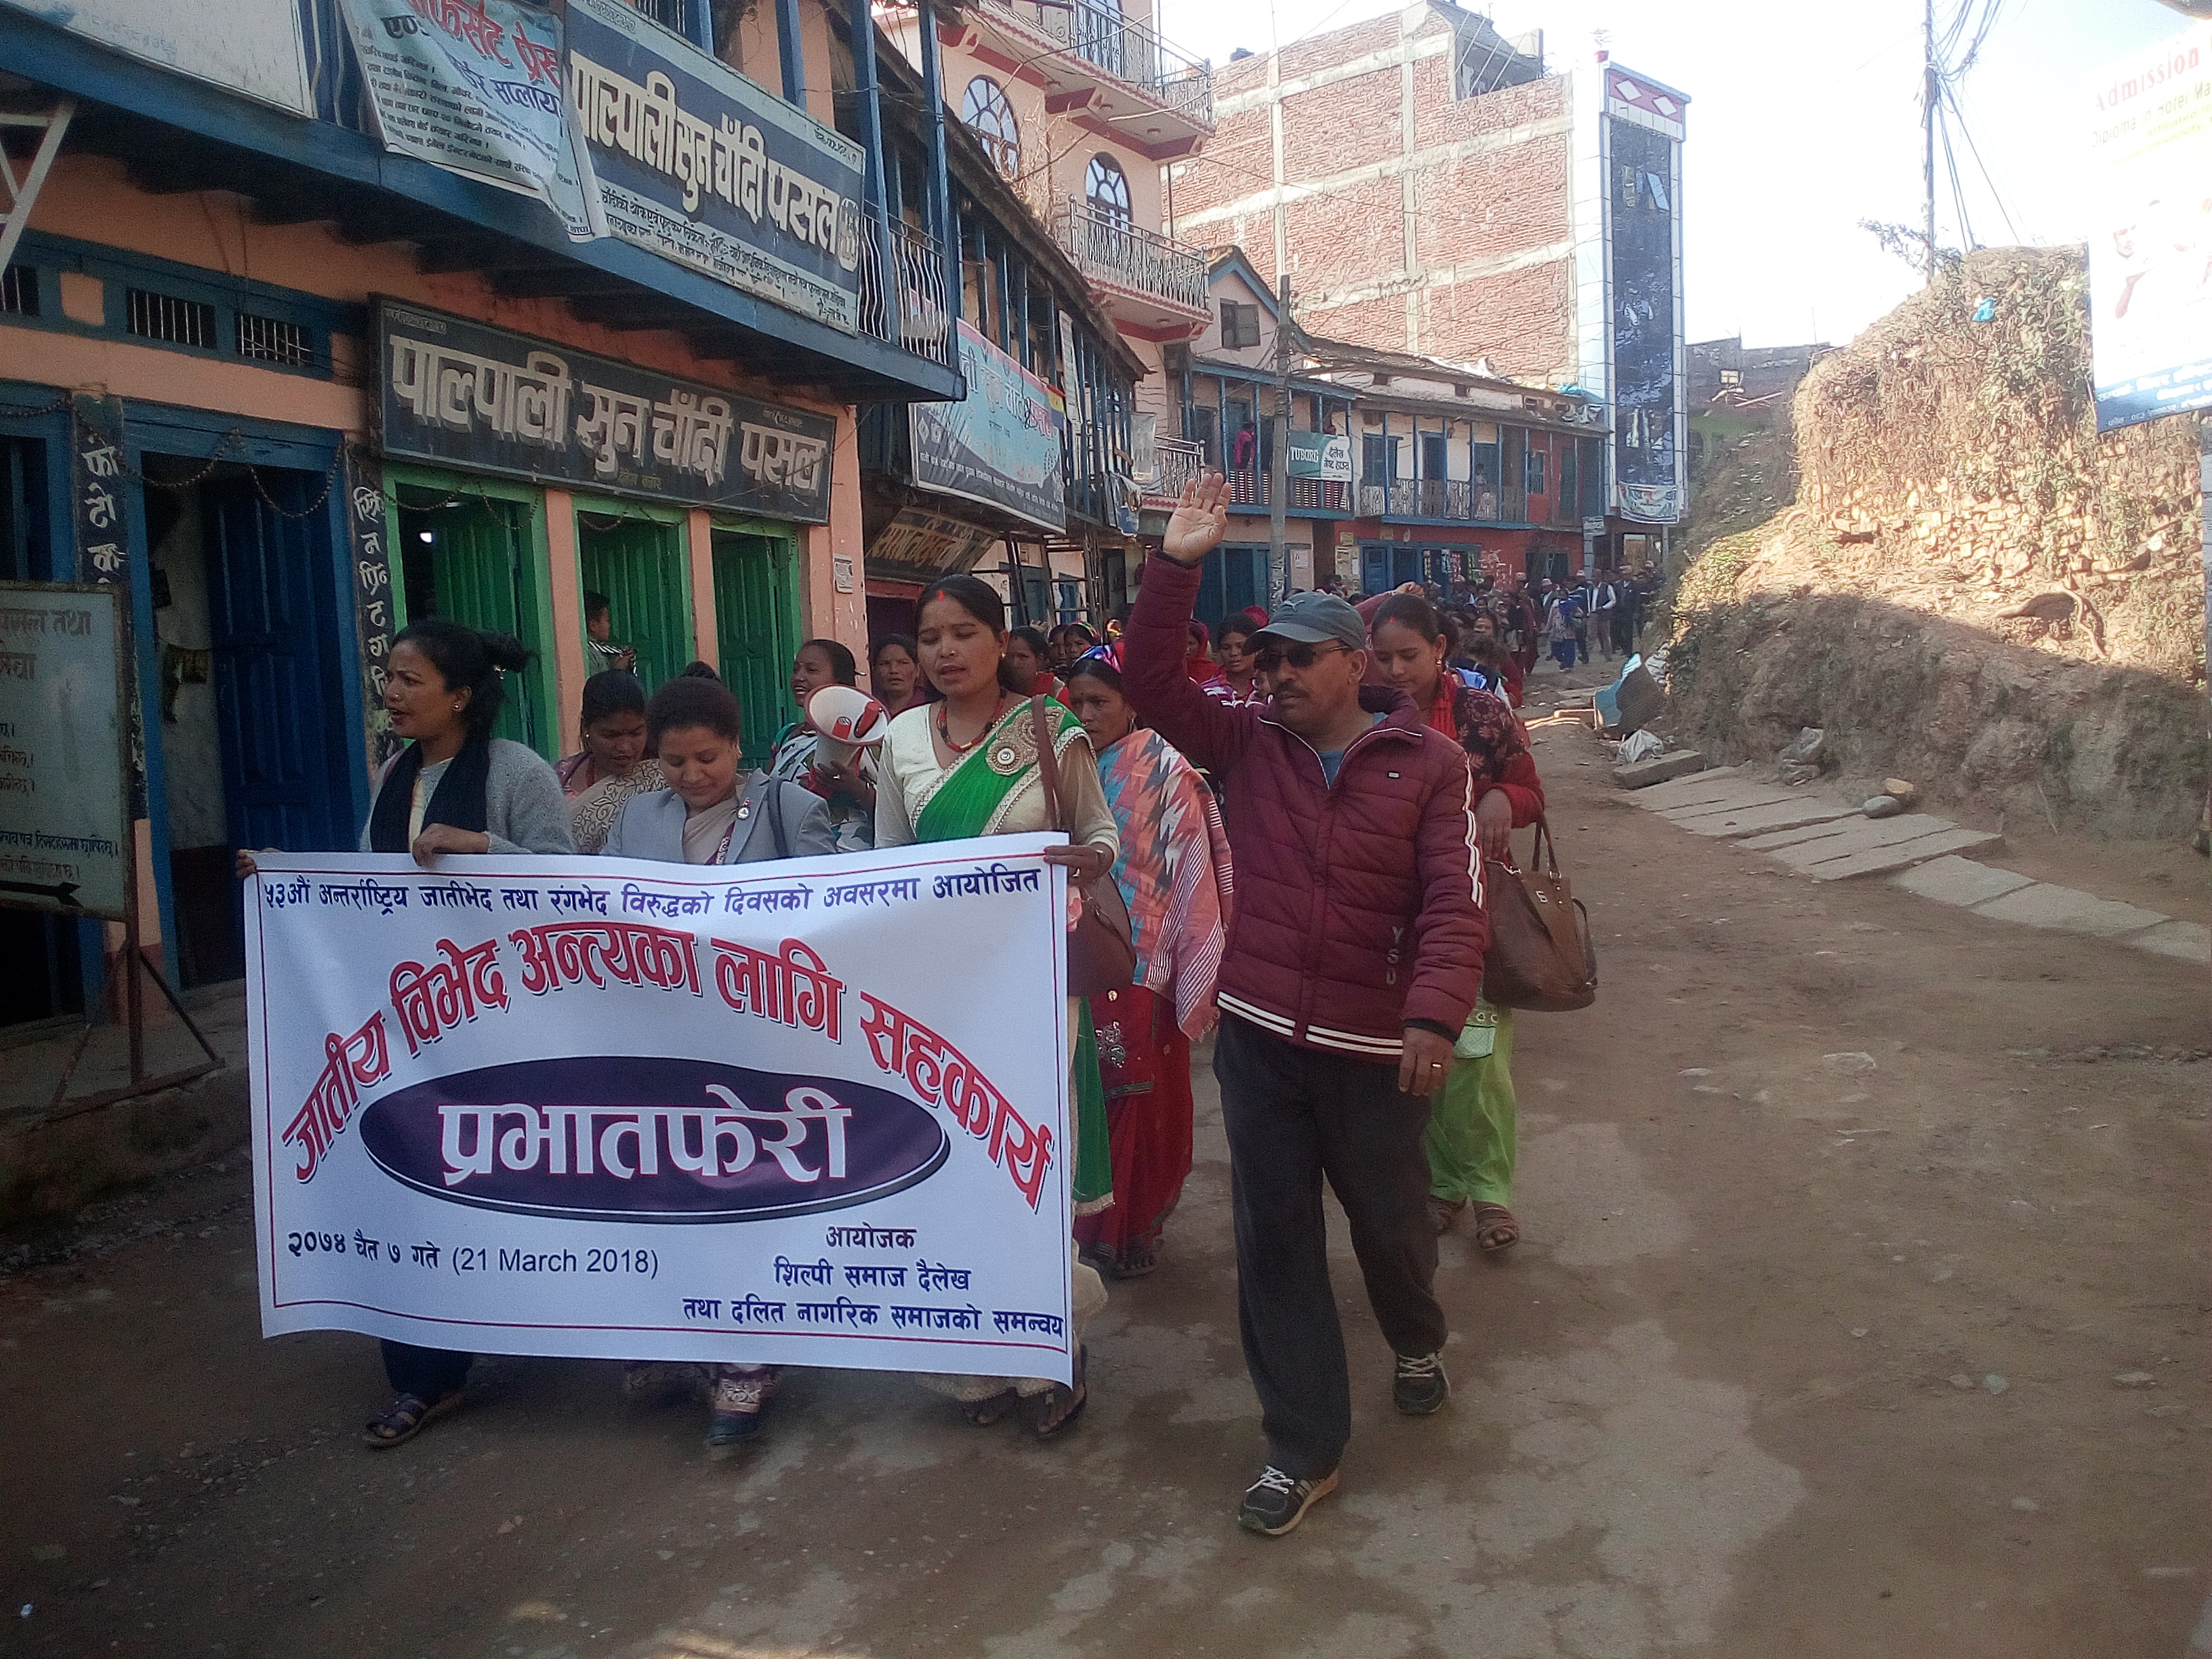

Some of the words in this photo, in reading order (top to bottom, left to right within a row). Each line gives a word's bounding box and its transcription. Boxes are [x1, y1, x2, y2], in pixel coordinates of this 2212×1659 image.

[2095, 47, 2199, 111] Admission
[766, 157, 841, 255] पसल
[390, 335, 573, 452] पाल्पाली
[576, 383, 651, 473] सुन
[741, 422, 827, 492] पसल
[1290, 445, 1319, 464] TUBORG
[419, 881, 493, 913] जातीभेद
[501, 888, 538, 912] तथा
[549, 884, 610, 916] रंगभेद
[621, 882, 714, 918] विरुद्धको
[724, 883, 814, 915] दिवसको
[823, 878, 921, 907] अवसरमा
[933, 863, 1042, 899] आयोजित
[281, 1010, 392, 1184] जातीय
[390, 938, 512, 1057] विभेद
[508, 920, 703, 996] अन्त्यका
[710, 938, 846, 1044] लागि
[859, 990, 1055, 1215] सहकार्य
[438, 1083, 853, 1187] प्रभातफेरी
[288, 1231, 346, 1257] २०७४
[354, 1228, 380, 1261] चैत
[388, 1244, 402, 1264] ७
[411, 1241, 441, 1268] गते
[452, 1246, 487, 1276] (21
[499, 1248, 577, 1273] March
[586, 1248, 659, 1279] 2018)
[825, 1221, 918, 1250] आयोजक
[773, 1255, 834, 1288] शिल्पी
[842, 1265, 908, 1289] समाज
[916, 1258, 972, 1292] दैलेख
[682, 1298, 722, 1321] तथा
[731, 1292, 786, 1326] दलित
[796, 1295, 880, 1328] नागरिक
[890, 1302, 983, 1332] समाजको
[991, 1309, 1065, 1339] समन्वय
